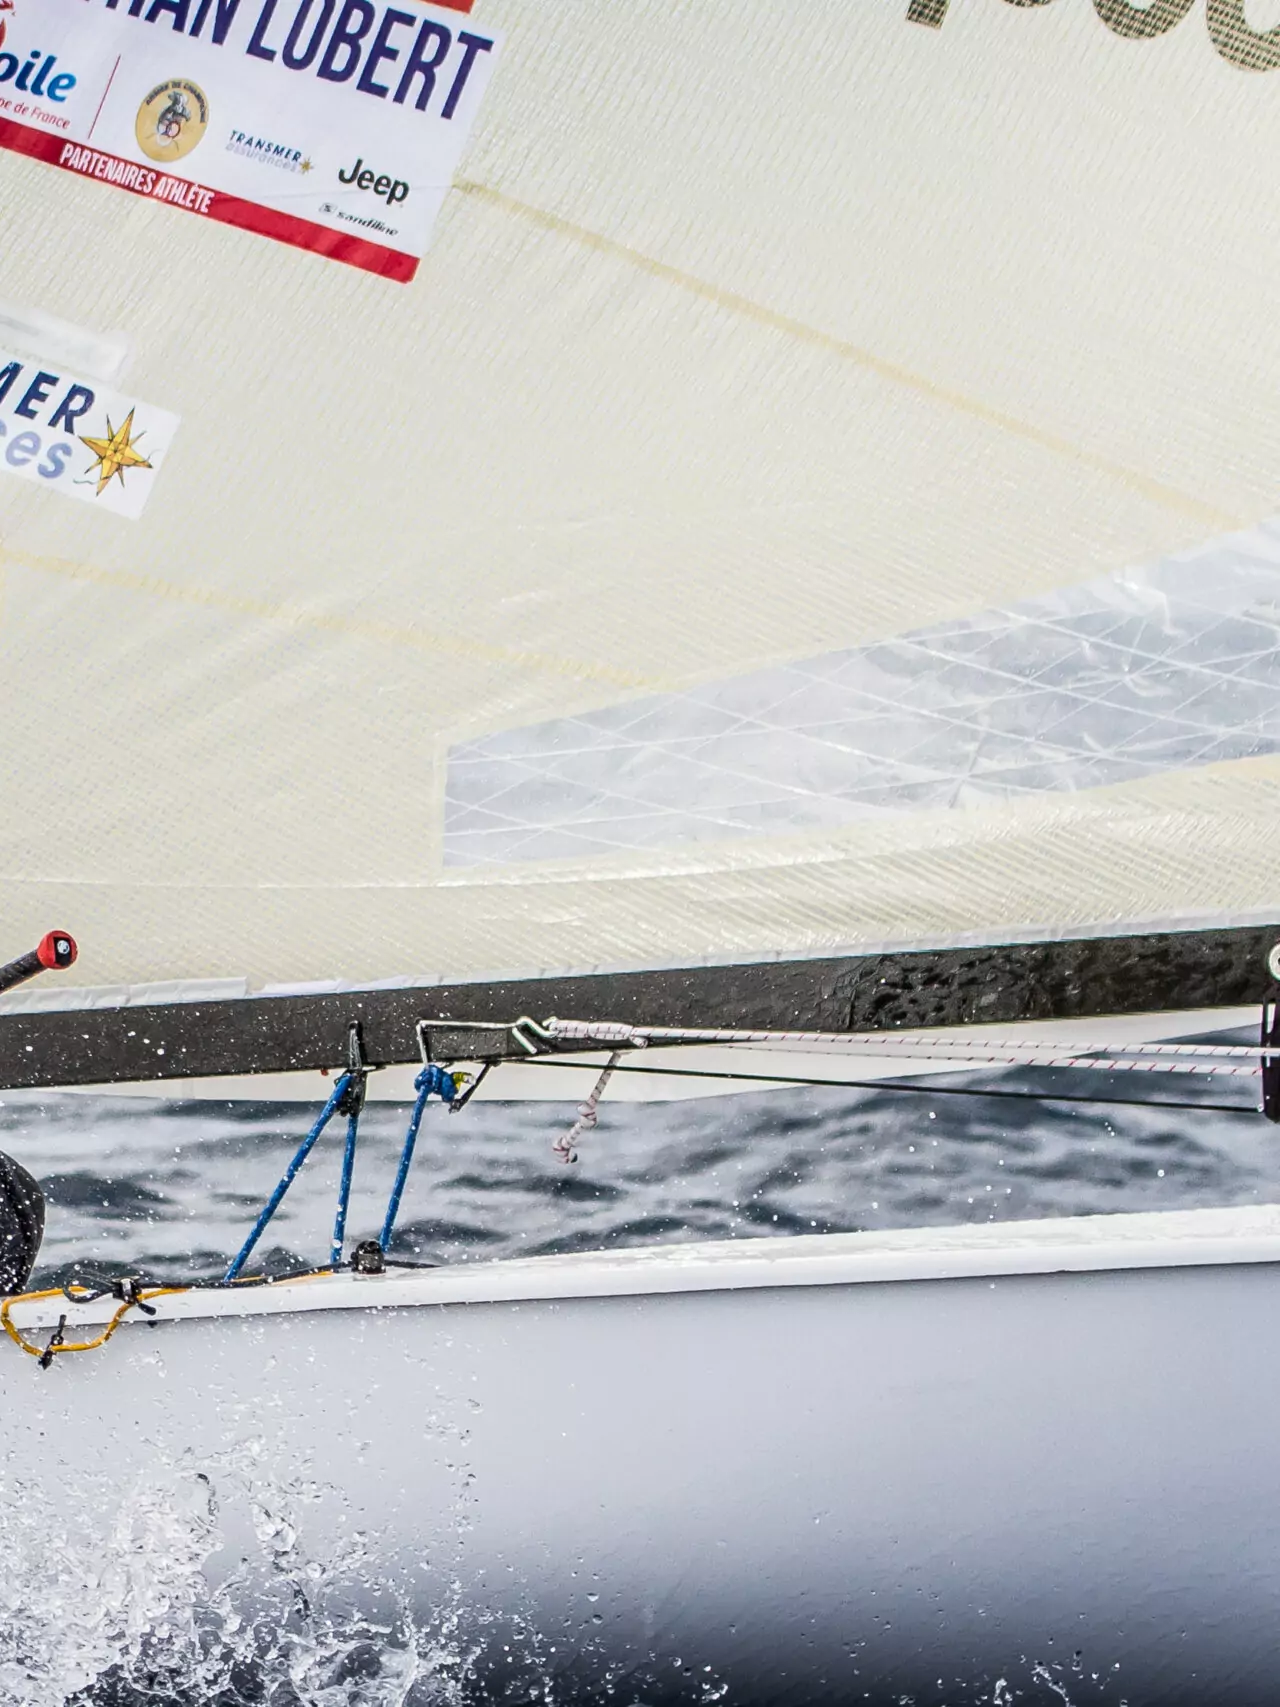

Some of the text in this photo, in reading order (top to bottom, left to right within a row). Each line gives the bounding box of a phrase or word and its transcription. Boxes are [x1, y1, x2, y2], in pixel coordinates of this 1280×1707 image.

[245, 0, 495, 120] LOBERT
[13, 101, 30, 116] de
[30, 107, 71, 130] France
[225, 142, 297, 173] assurances
[229, 129, 302, 163] TRANSMER
[59, 143, 157, 194] PARTENAIRES
[338, 158, 410, 206] Jeep
